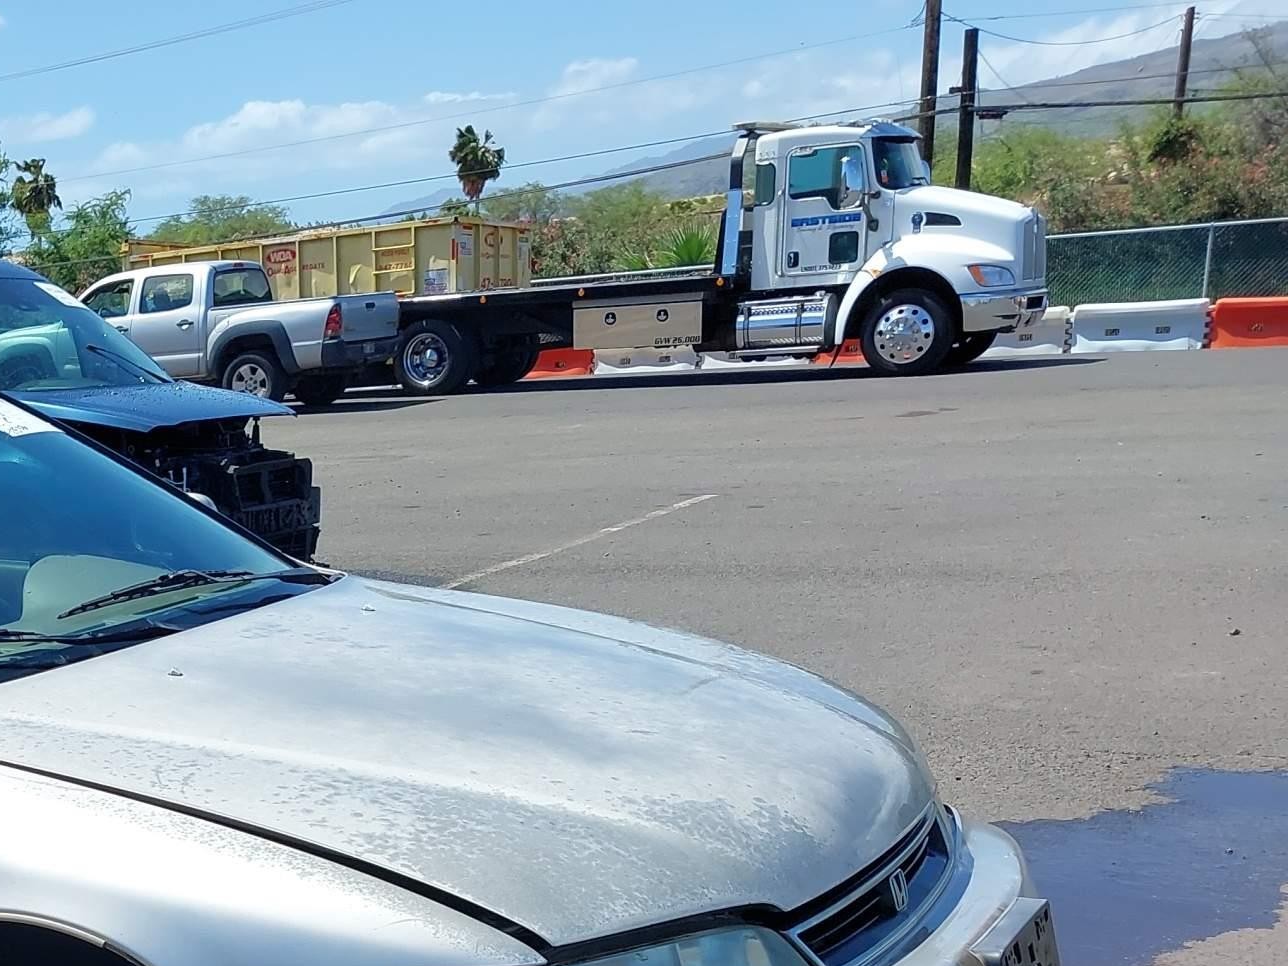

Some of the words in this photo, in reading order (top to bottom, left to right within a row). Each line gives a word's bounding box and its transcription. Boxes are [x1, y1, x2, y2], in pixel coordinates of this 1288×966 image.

[791, 212, 862, 228] EASTSIDE
[654, 336, 671, 345] GVW
[672, 335, 701, 345] 26,000
